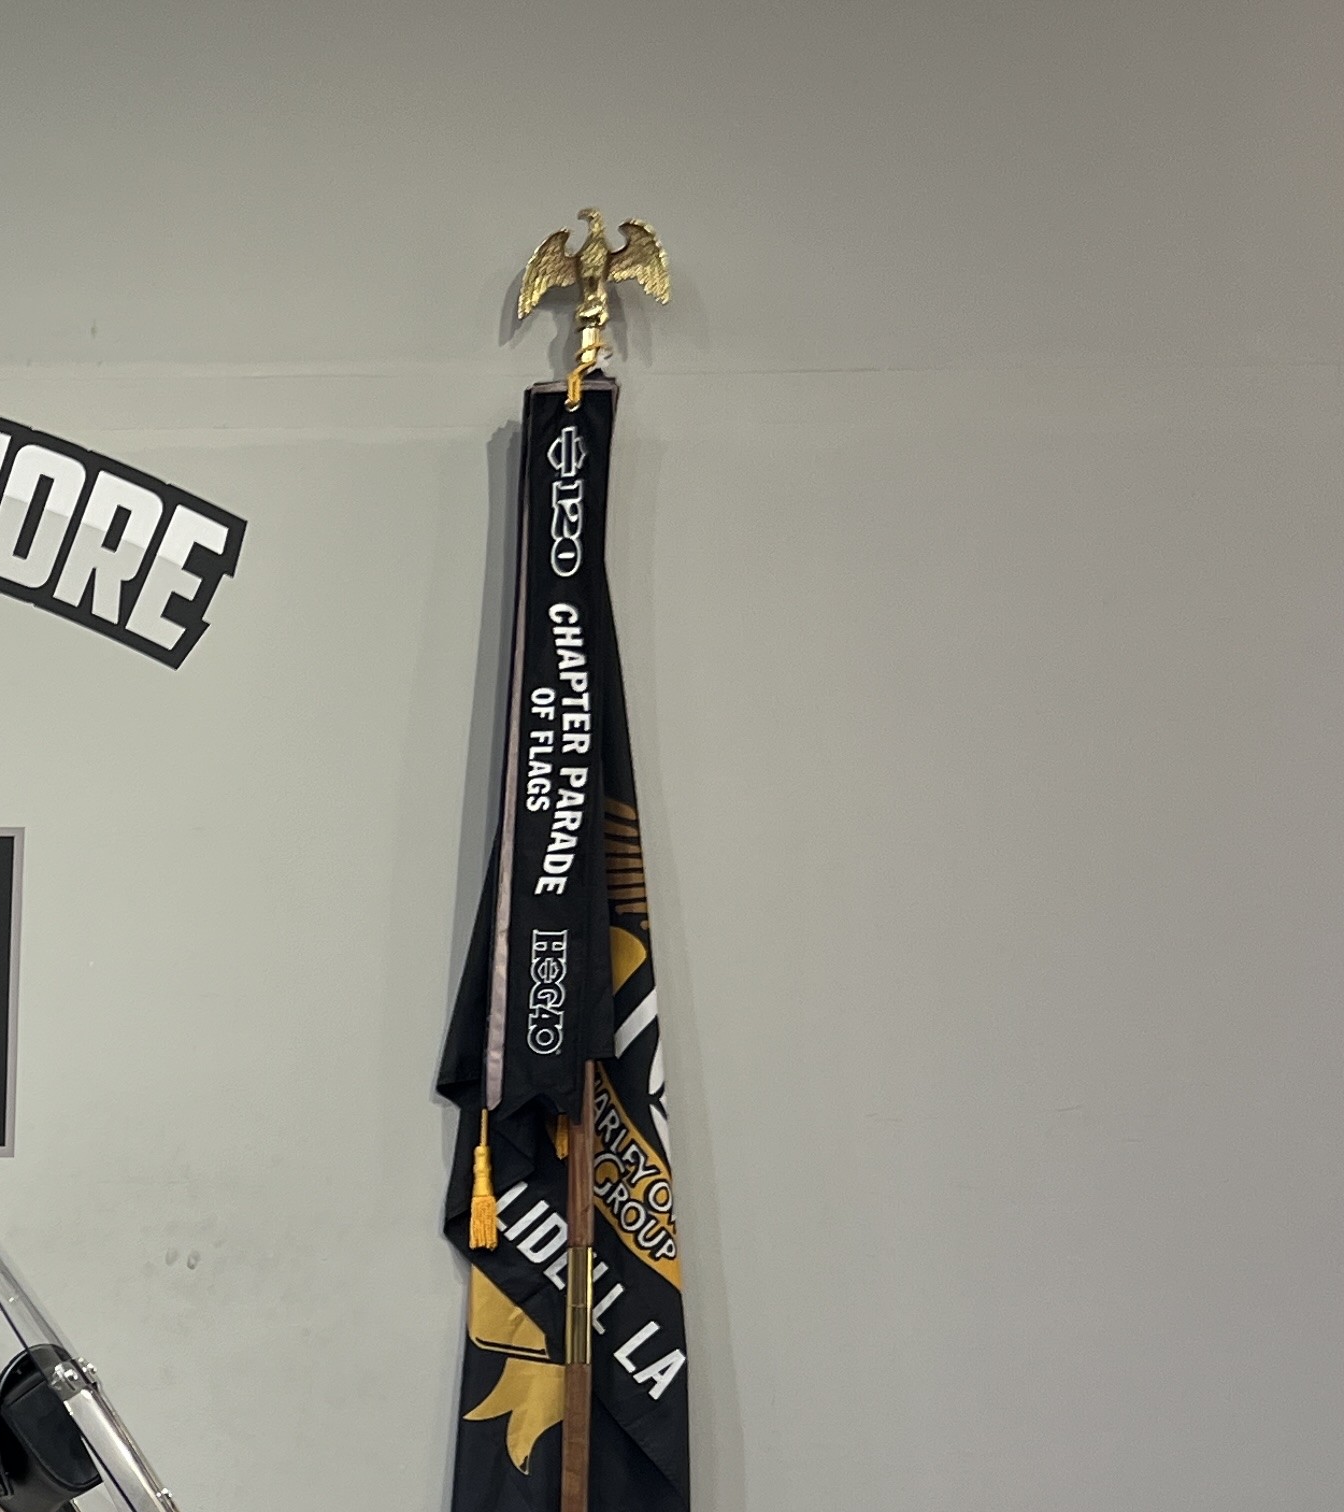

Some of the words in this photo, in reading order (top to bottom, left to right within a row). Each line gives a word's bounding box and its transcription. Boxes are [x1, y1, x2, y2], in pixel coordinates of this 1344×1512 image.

[530, 687, 555, 720] OF
[548, 603, 591, 754] CHAPTER
[526, 730, 554, 812] FLAGS
[534, 767, 588, 895] PARADE
[593, 1153, 677, 1258] GROUP
[613, 1320, 686, 1400] LA
